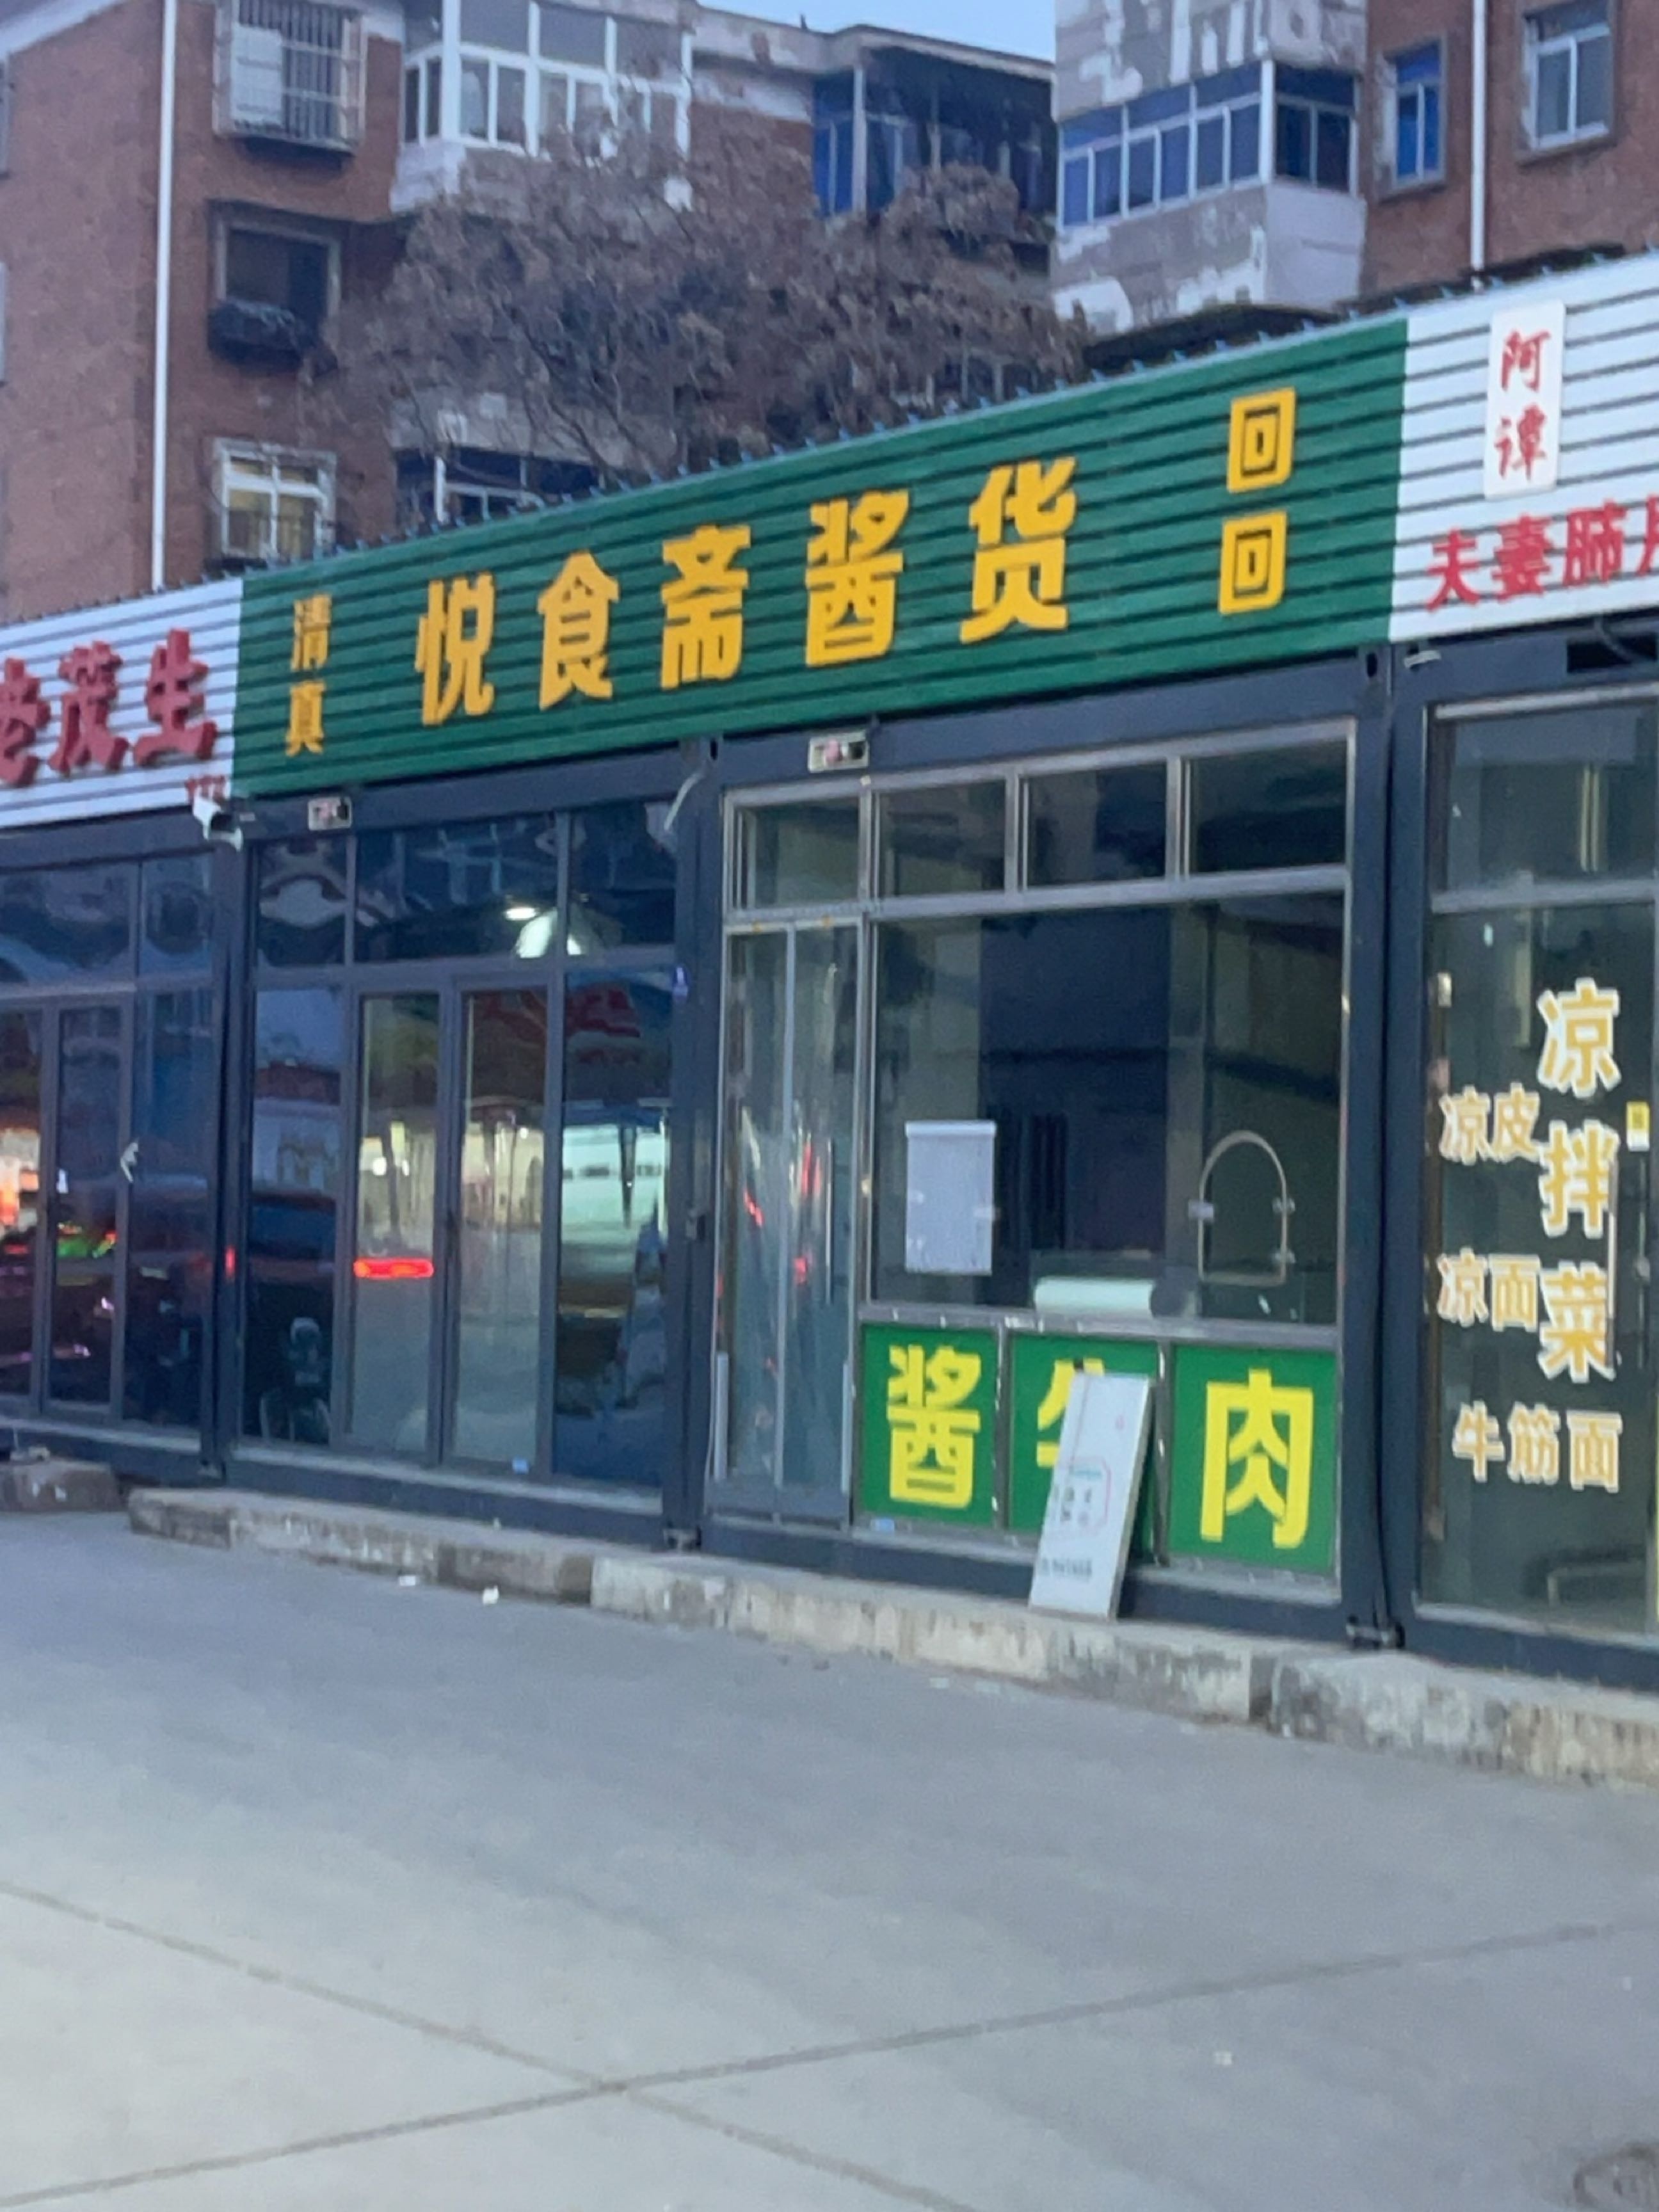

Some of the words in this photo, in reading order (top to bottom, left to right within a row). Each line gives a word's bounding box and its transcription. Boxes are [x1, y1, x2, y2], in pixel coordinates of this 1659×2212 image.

[415, 455, 1078, 726] 悦食斋酱货
[285, 593, 332, 757] 清真
[1439, 1082, 1541, 1165] 凉皮
[1537, 977, 1621, 1384] 凉拌菜
[1438, 1247, 1541, 1331] 凉面
[1452, 1401, 1623, 1493] 牛筋面
